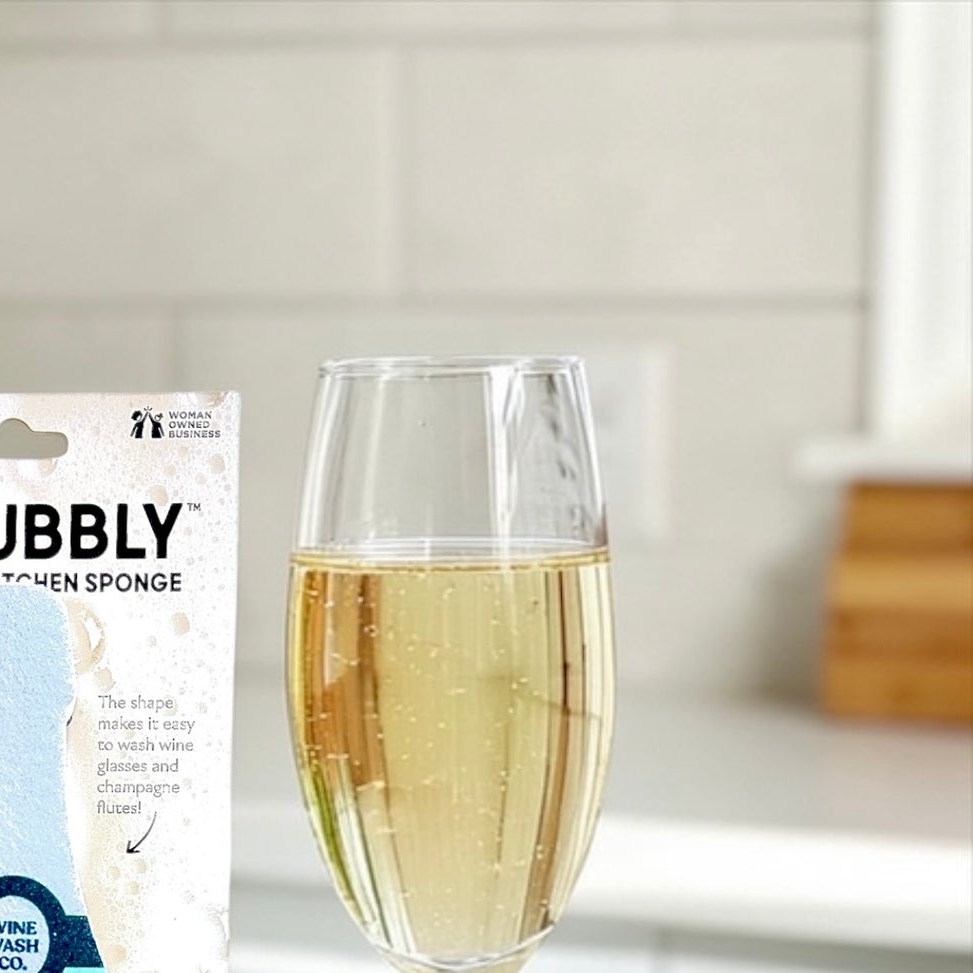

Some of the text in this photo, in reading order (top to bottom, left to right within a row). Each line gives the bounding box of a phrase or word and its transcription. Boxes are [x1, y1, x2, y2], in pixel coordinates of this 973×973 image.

[168, 411, 212, 419] WOMAN
[168, 420, 210, 429] OWNED
[168, 430, 221, 438] BUSINESS
[85, 573, 182, 592] SPONGE
[98, 695, 174, 713] The shape
[98, 716, 196, 734] makes it easy
[97, 737, 194, 751] to wash wine
[96, 758, 179, 776] glasses and
[96, 779, 180, 798] champagne
[96, 800, 142, 814] flutes!
